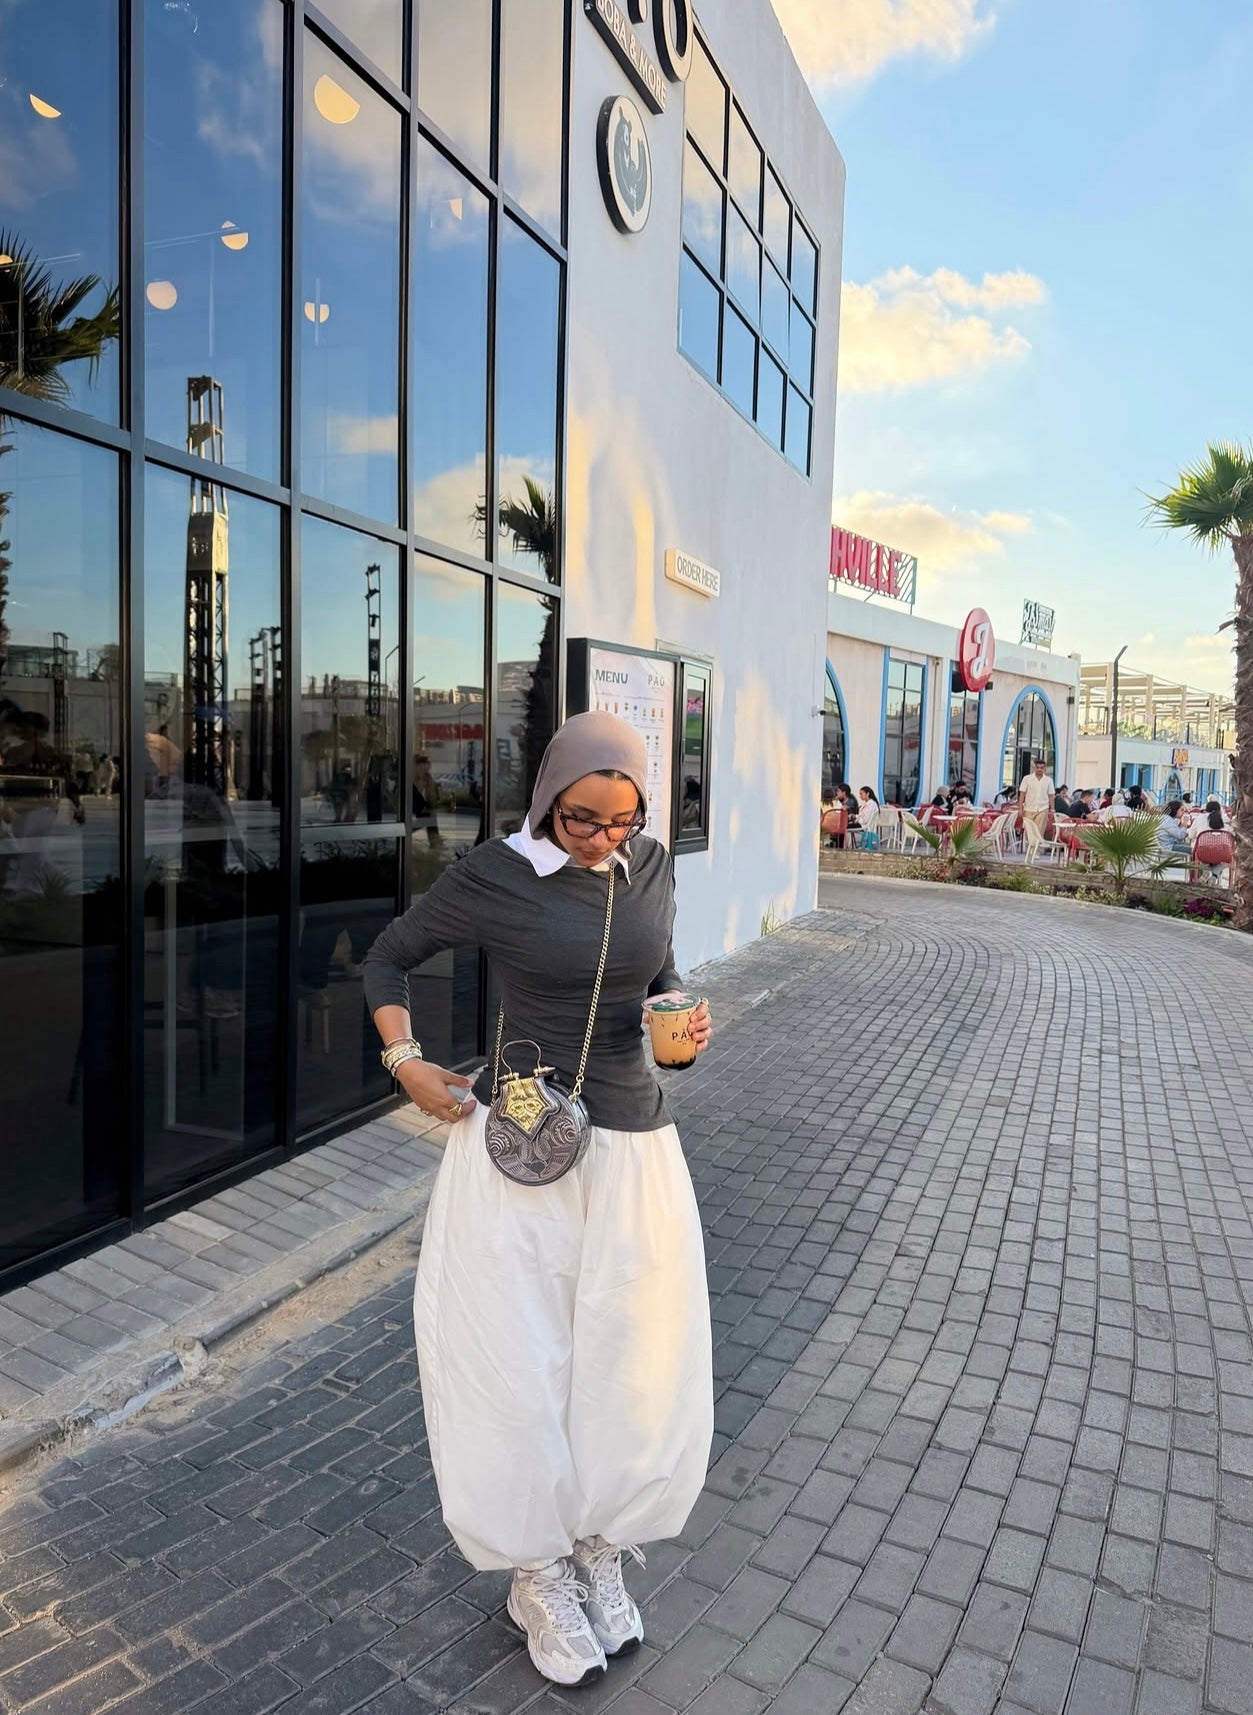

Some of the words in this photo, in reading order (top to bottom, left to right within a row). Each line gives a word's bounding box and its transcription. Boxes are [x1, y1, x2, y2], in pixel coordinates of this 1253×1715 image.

[629, 33, 640, 67] &
[640, 48, 666, 108] MORE
[677, 556, 701, 583] ORDER
[701, 568, 719, 591] HERE
[595, 669, 628, 684] MENU
